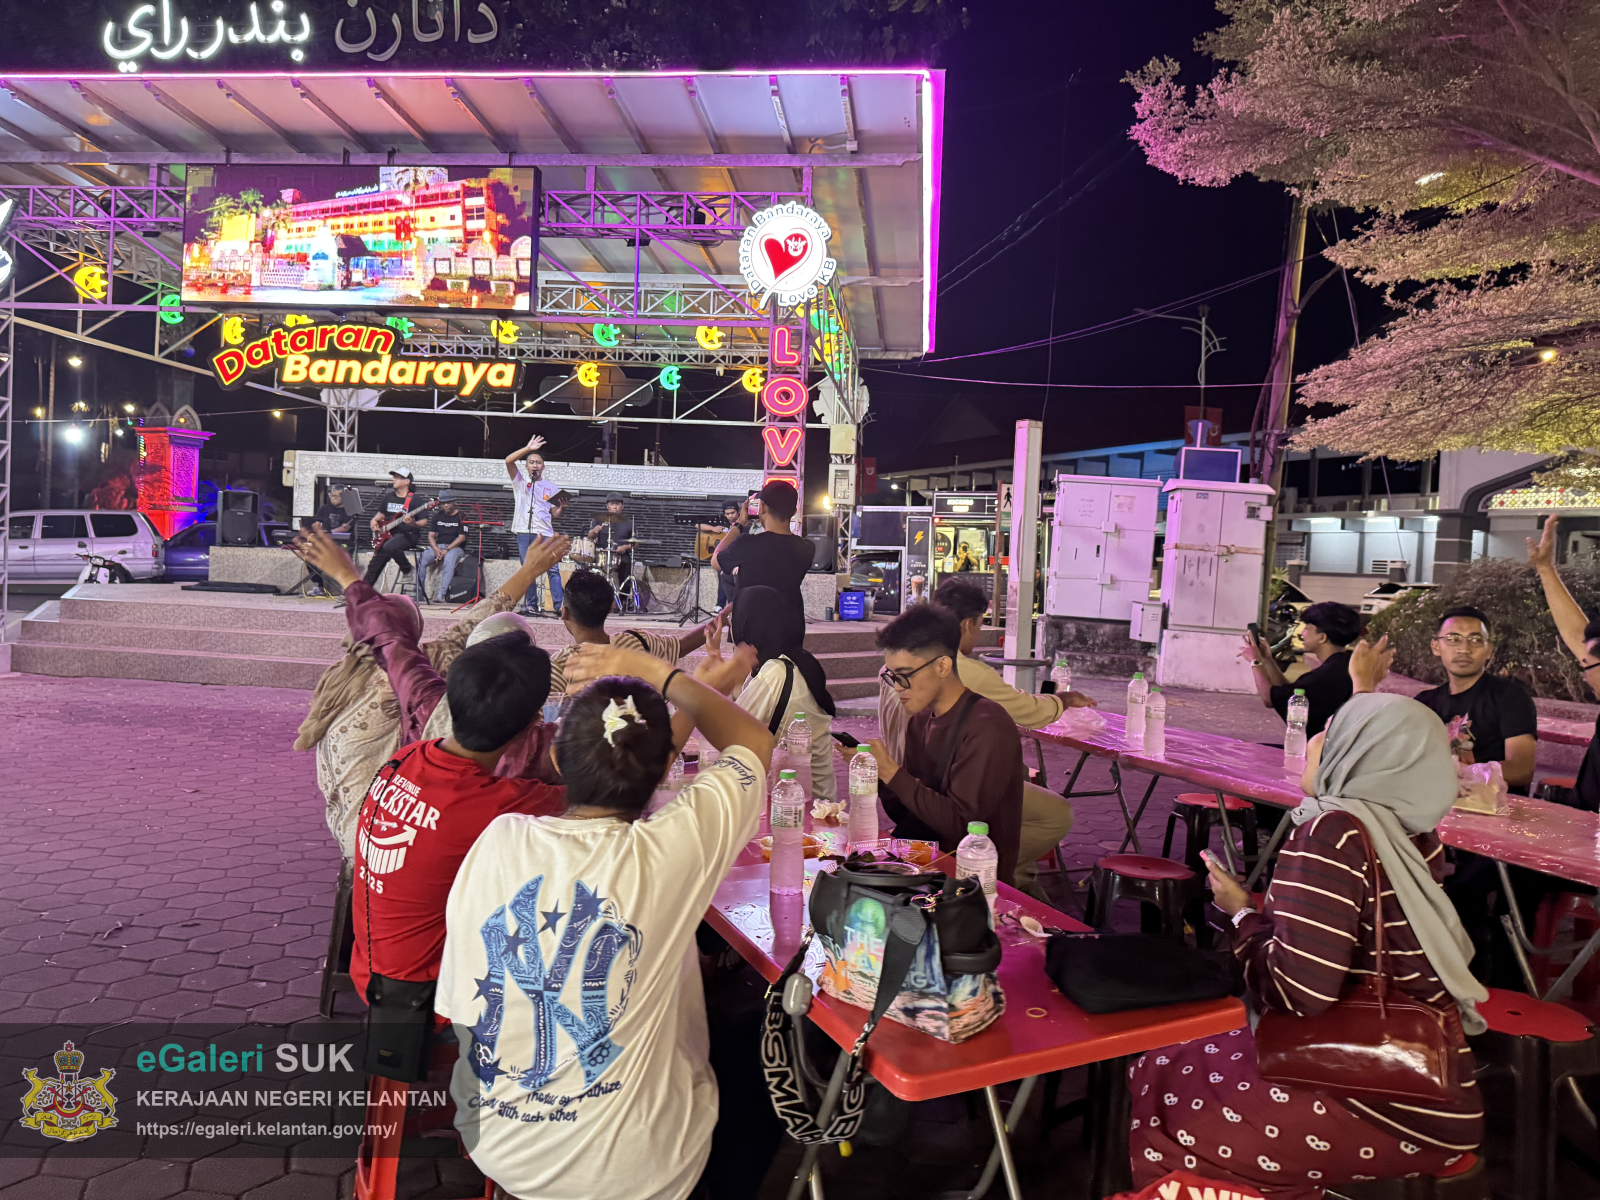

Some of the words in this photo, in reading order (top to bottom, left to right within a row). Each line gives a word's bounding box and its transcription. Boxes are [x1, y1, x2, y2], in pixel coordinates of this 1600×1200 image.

[741, 228, 761, 291] Dataran
[755, 204, 830, 239] Bandaraya
[779, 286, 815, 304] Love
[818, 260, 835, 283] KB
[213, 324, 394, 386] Dataran
[282, 354, 516, 398] Bandaraya
[761, 326, 809, 491] LOV
[369, 775, 440, 830] ROCKSTAR
[391, 774, 421, 797] REVENUE
[549, 1108, 578, 1122] other
